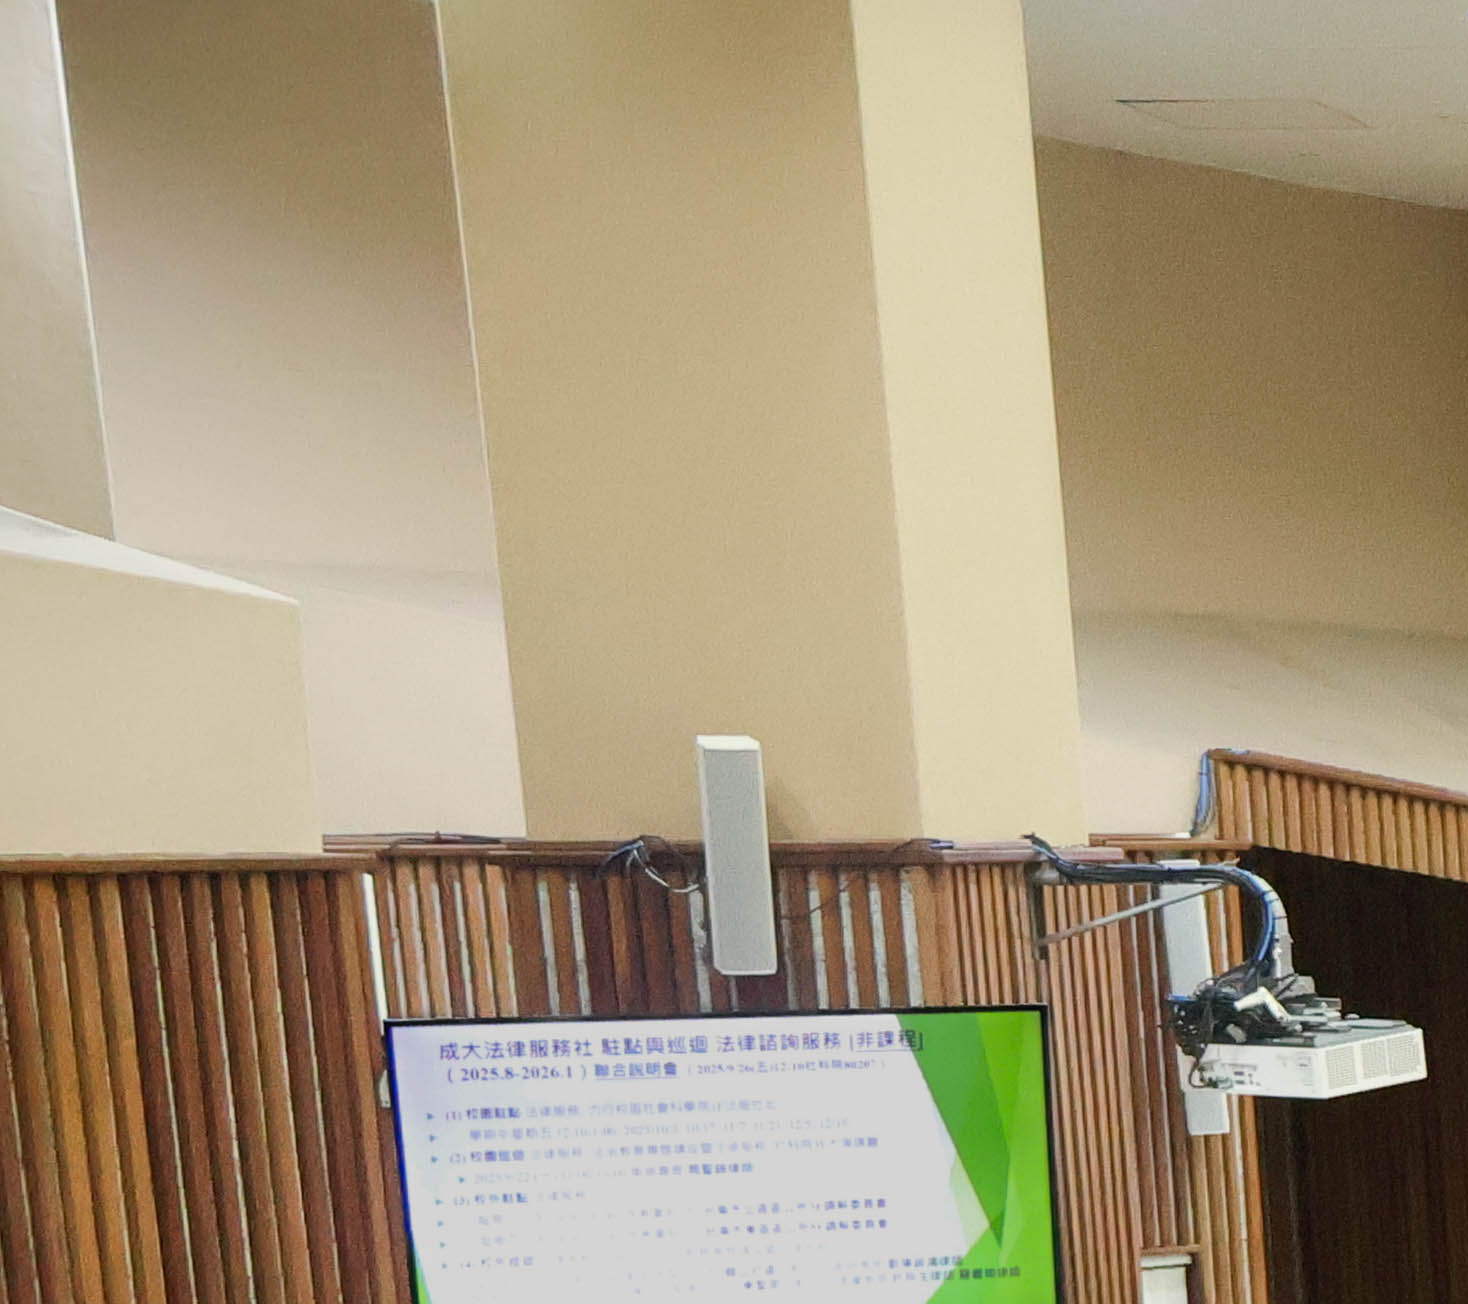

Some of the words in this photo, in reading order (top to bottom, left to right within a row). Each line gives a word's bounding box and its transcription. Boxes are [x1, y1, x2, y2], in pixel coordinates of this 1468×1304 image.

[440, 1037, 593, 1061] 成大法律服務社
[601, 1034, 709, 1056] 駐點與巡迴
[716, 1031, 841, 1054] 法律諮詢服務
